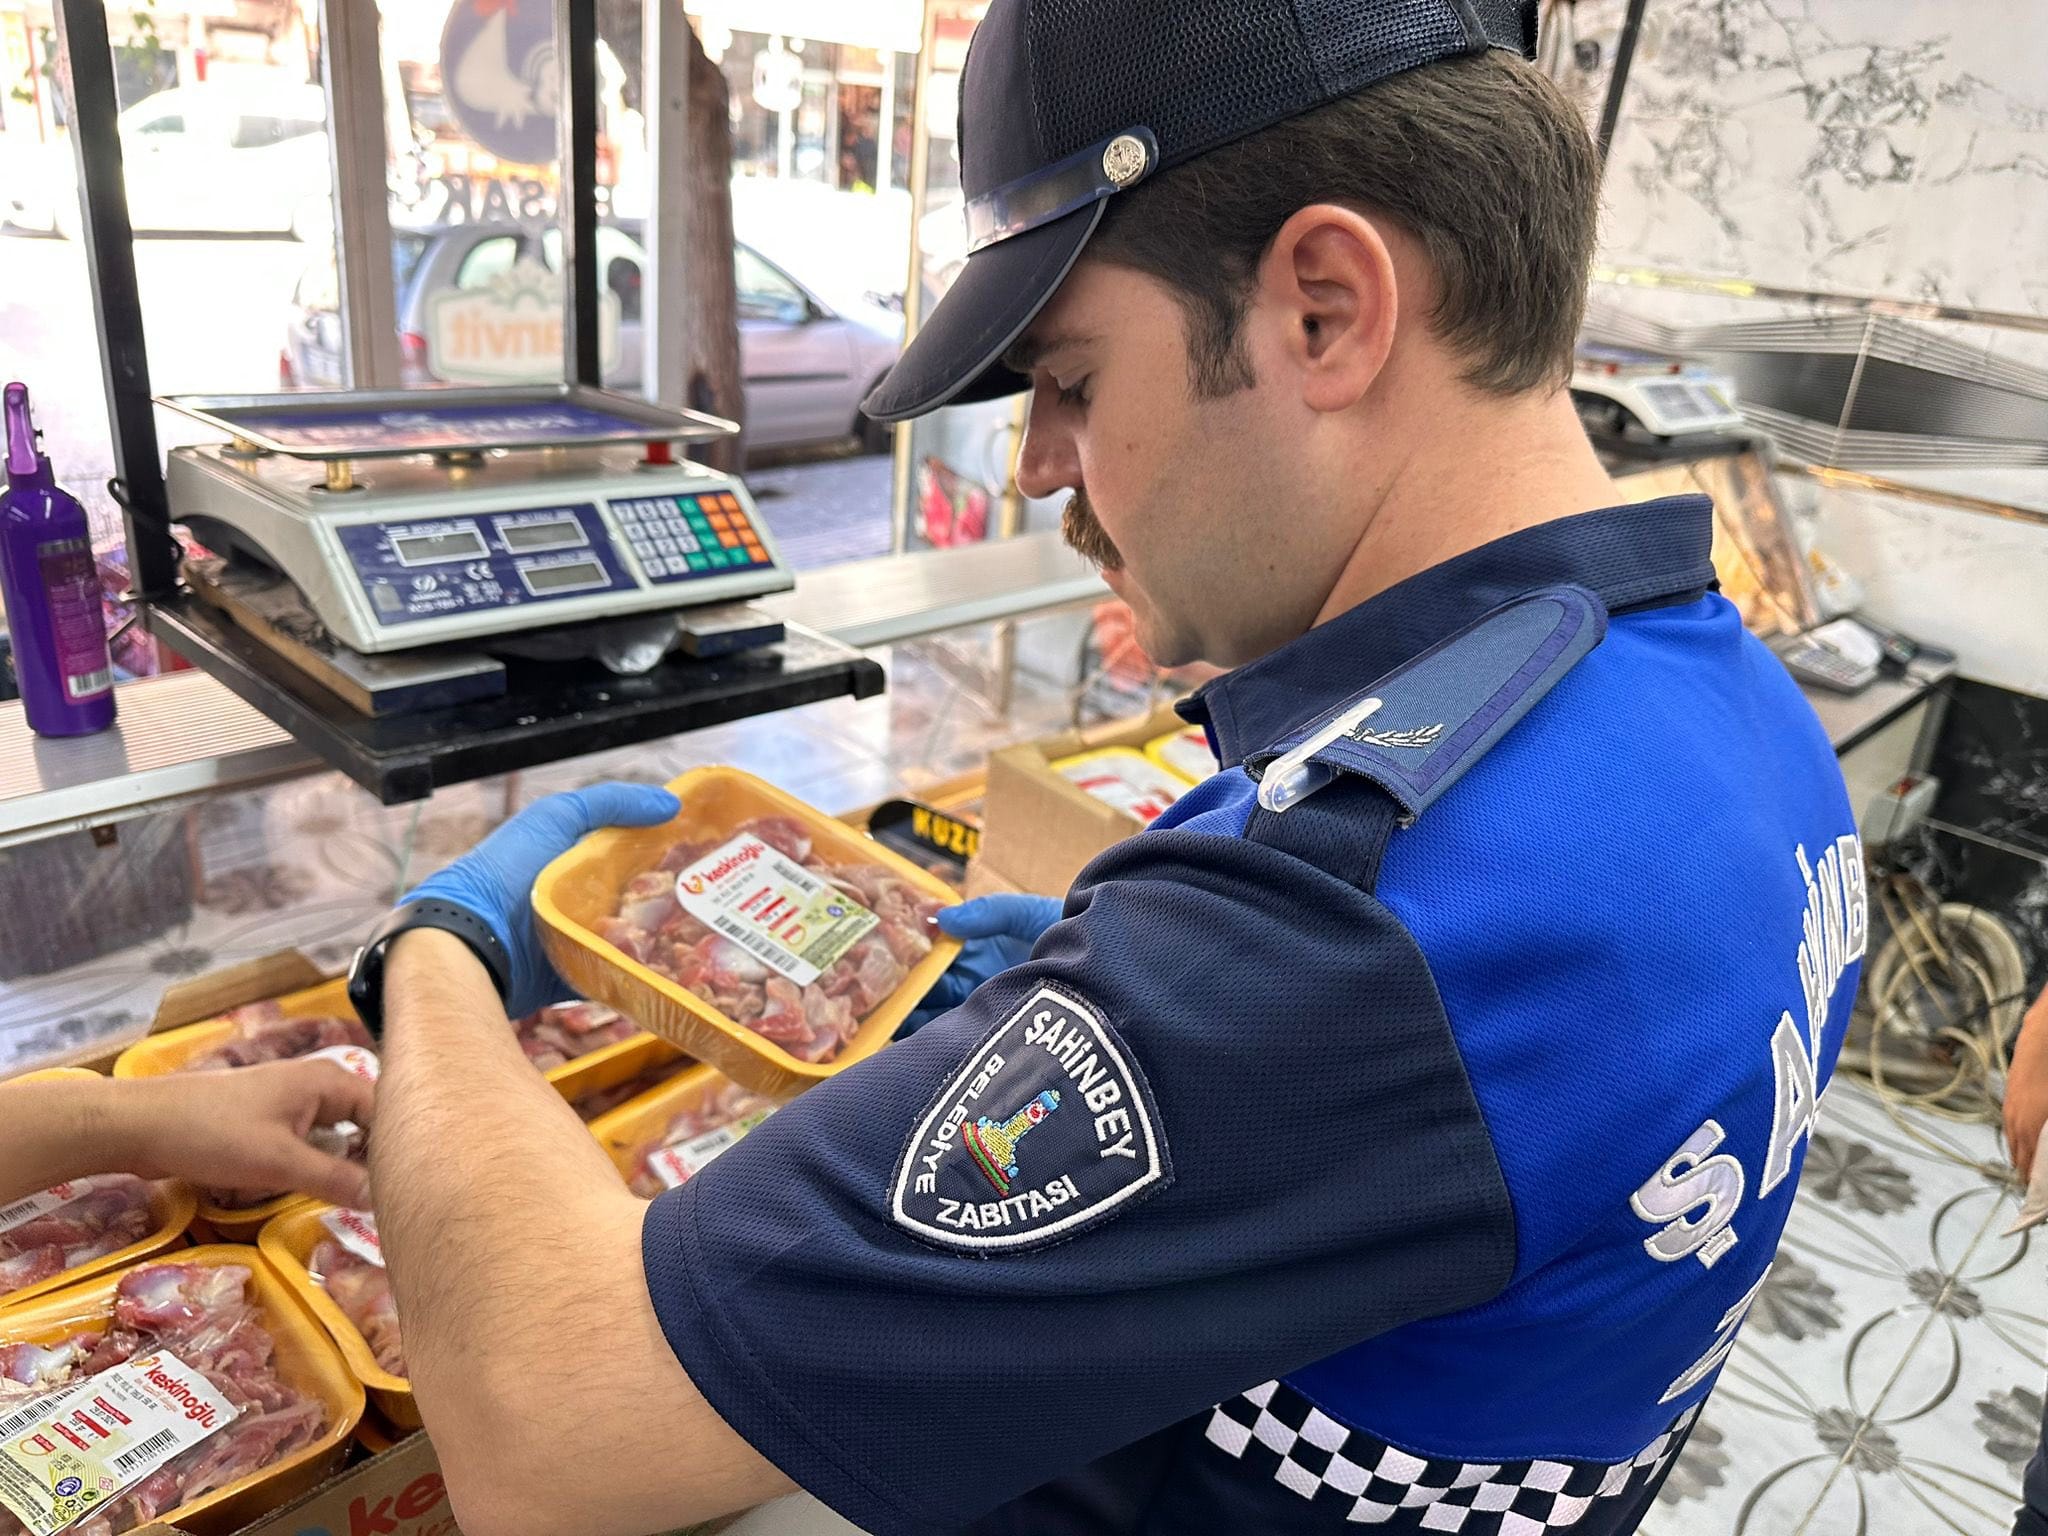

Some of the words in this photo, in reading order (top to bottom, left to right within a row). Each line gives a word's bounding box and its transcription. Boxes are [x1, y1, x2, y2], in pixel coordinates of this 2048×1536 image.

[1024, 1009, 1136, 1160] ŞAHİNBEY
[935, 1174, 1081, 1230] ZABITASI
[144, 1364, 220, 1430] keskinoğlu
